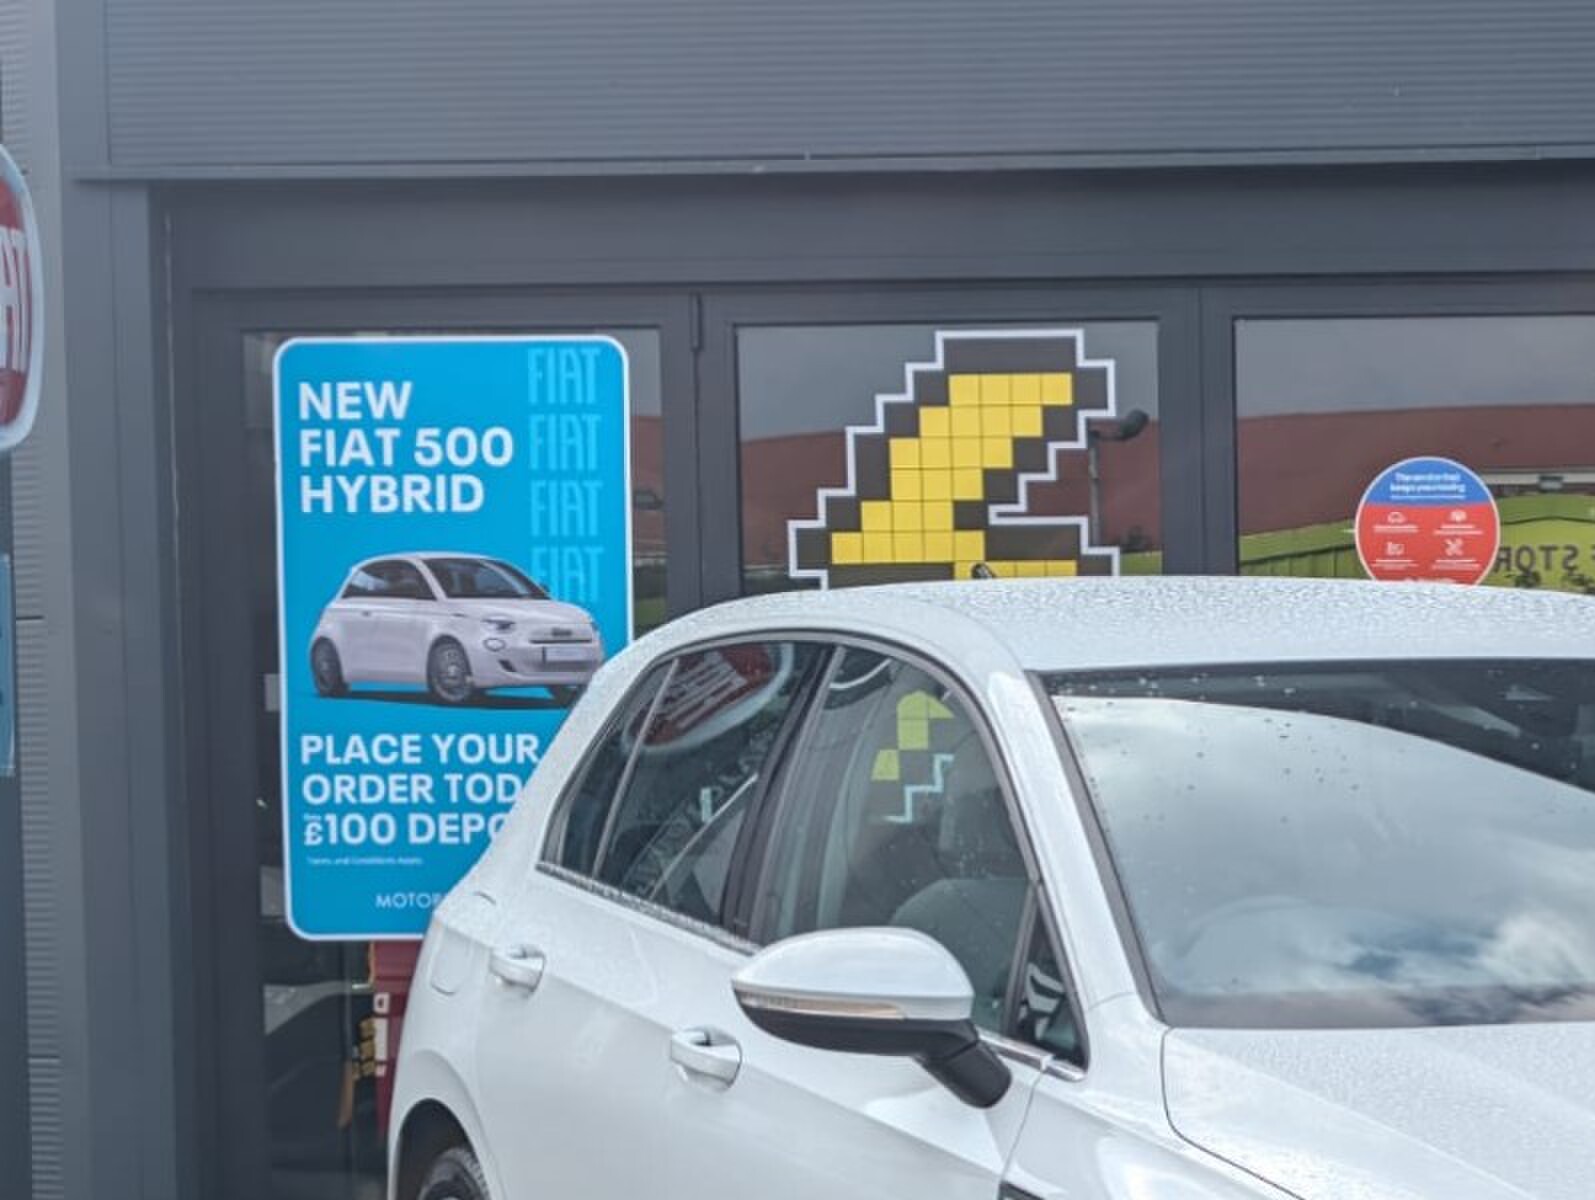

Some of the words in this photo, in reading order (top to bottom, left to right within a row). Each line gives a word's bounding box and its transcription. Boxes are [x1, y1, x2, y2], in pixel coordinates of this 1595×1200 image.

[528, 348, 600, 404] FIAT
[299, 381, 412, 420] NEW
[300, 429, 400, 467] FIAT
[413, 427, 514, 467] 500
[529, 415, 602, 470] FIAT
[301, 474, 485, 513] HYBRID
[530, 481, 603, 536] FIAT
[532, 547, 604, 602] FIAT
[301, 733, 422, 765] PLACE
[432, 733, 539, 764] YOUR
[302, 773, 435, 805] ORDER
[303, 813, 396, 847] £100
